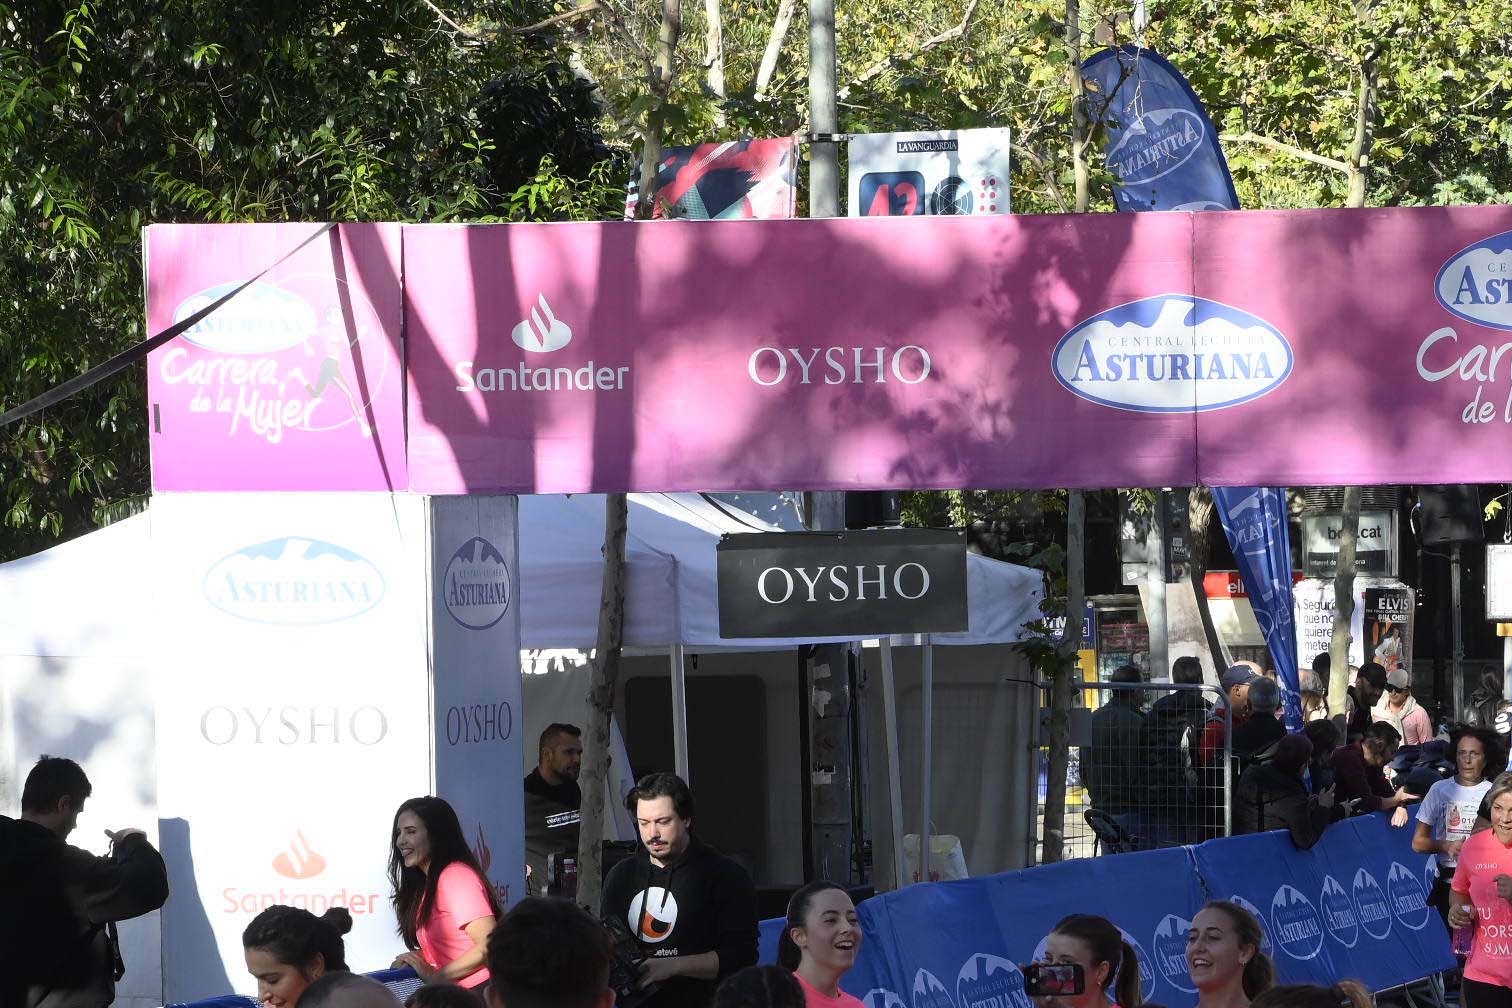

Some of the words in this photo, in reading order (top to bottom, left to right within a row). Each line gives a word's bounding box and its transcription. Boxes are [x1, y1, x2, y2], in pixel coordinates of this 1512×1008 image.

[1108, 336, 1183, 346] CENTRAL
[161, 347, 280, 384] Carrera
[456, 361, 630, 392] Santander
[747, 344, 932, 386] OYSHO
[1070, 338, 1275, 382] ASTURIANA
[189, 387, 212, 413] de
[215, 383, 233, 413] la
[229, 380, 324, 444] Mujer
[1461, 386, 1498, 424] de
[218, 571, 371, 603] ASTURIANA
[449, 571, 507, 608] ASTURIANA
[757, 562, 930, 604] OYSHO
[1378, 597, 1409, 610] ELVIS
[199, 704, 389, 746] OYSHO
[446, 700, 512, 746] OYSHO
